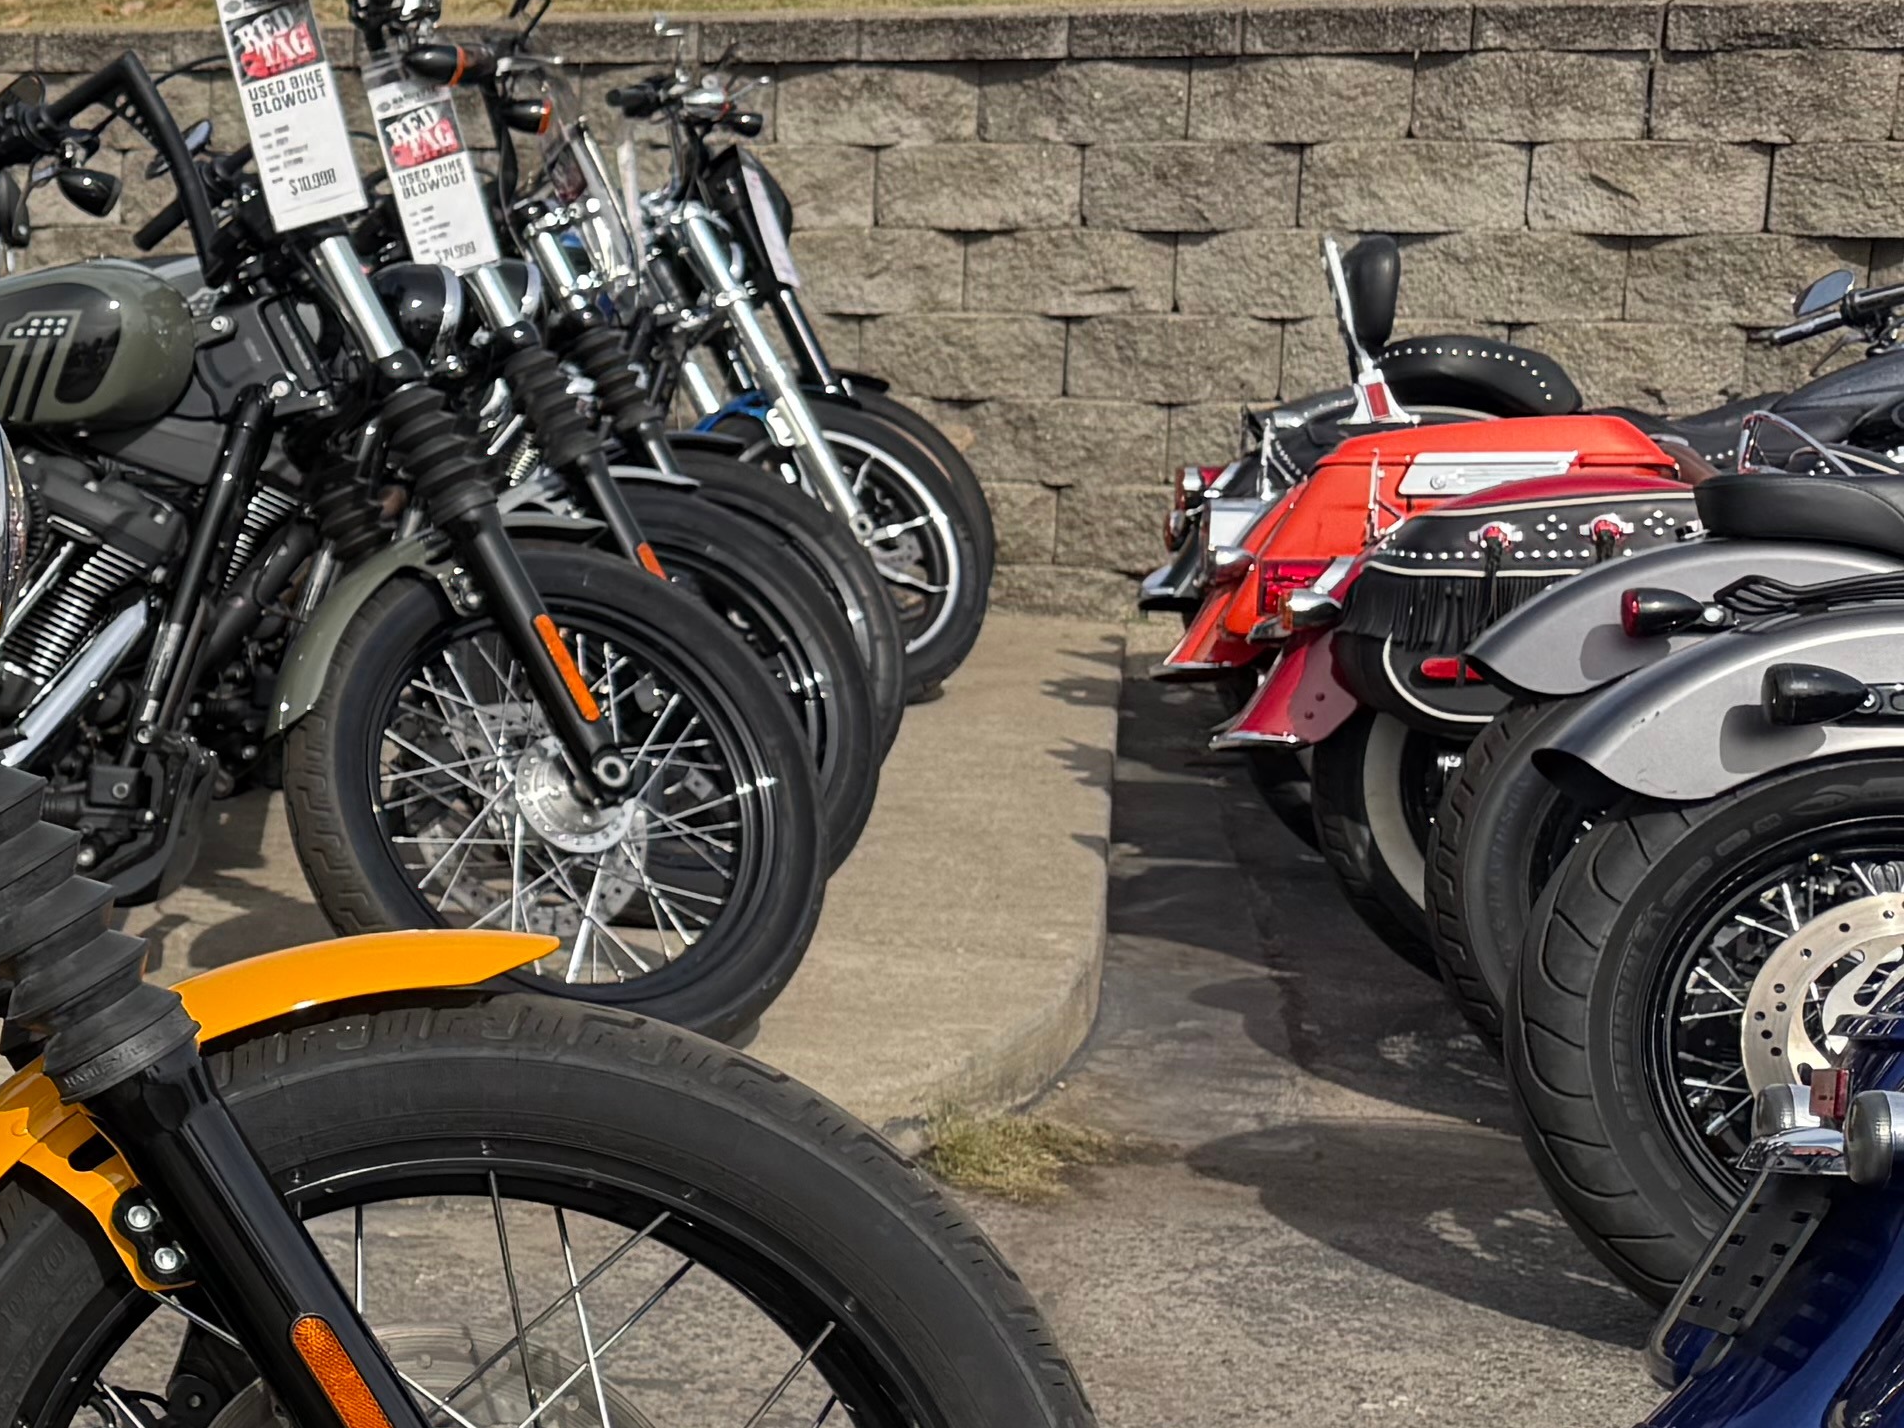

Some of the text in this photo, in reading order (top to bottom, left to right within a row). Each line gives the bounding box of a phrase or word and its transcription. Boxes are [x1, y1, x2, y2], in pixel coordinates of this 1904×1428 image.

[233, 7, 294, 54] RED
[259, 21, 315, 69] TAG
[248, 68, 324, 102] USED BIKE
[252, 83, 327, 118] BLOWOUT
[398, 167, 431, 188] USED
[402, 171, 467, 201] BLOWOUT
